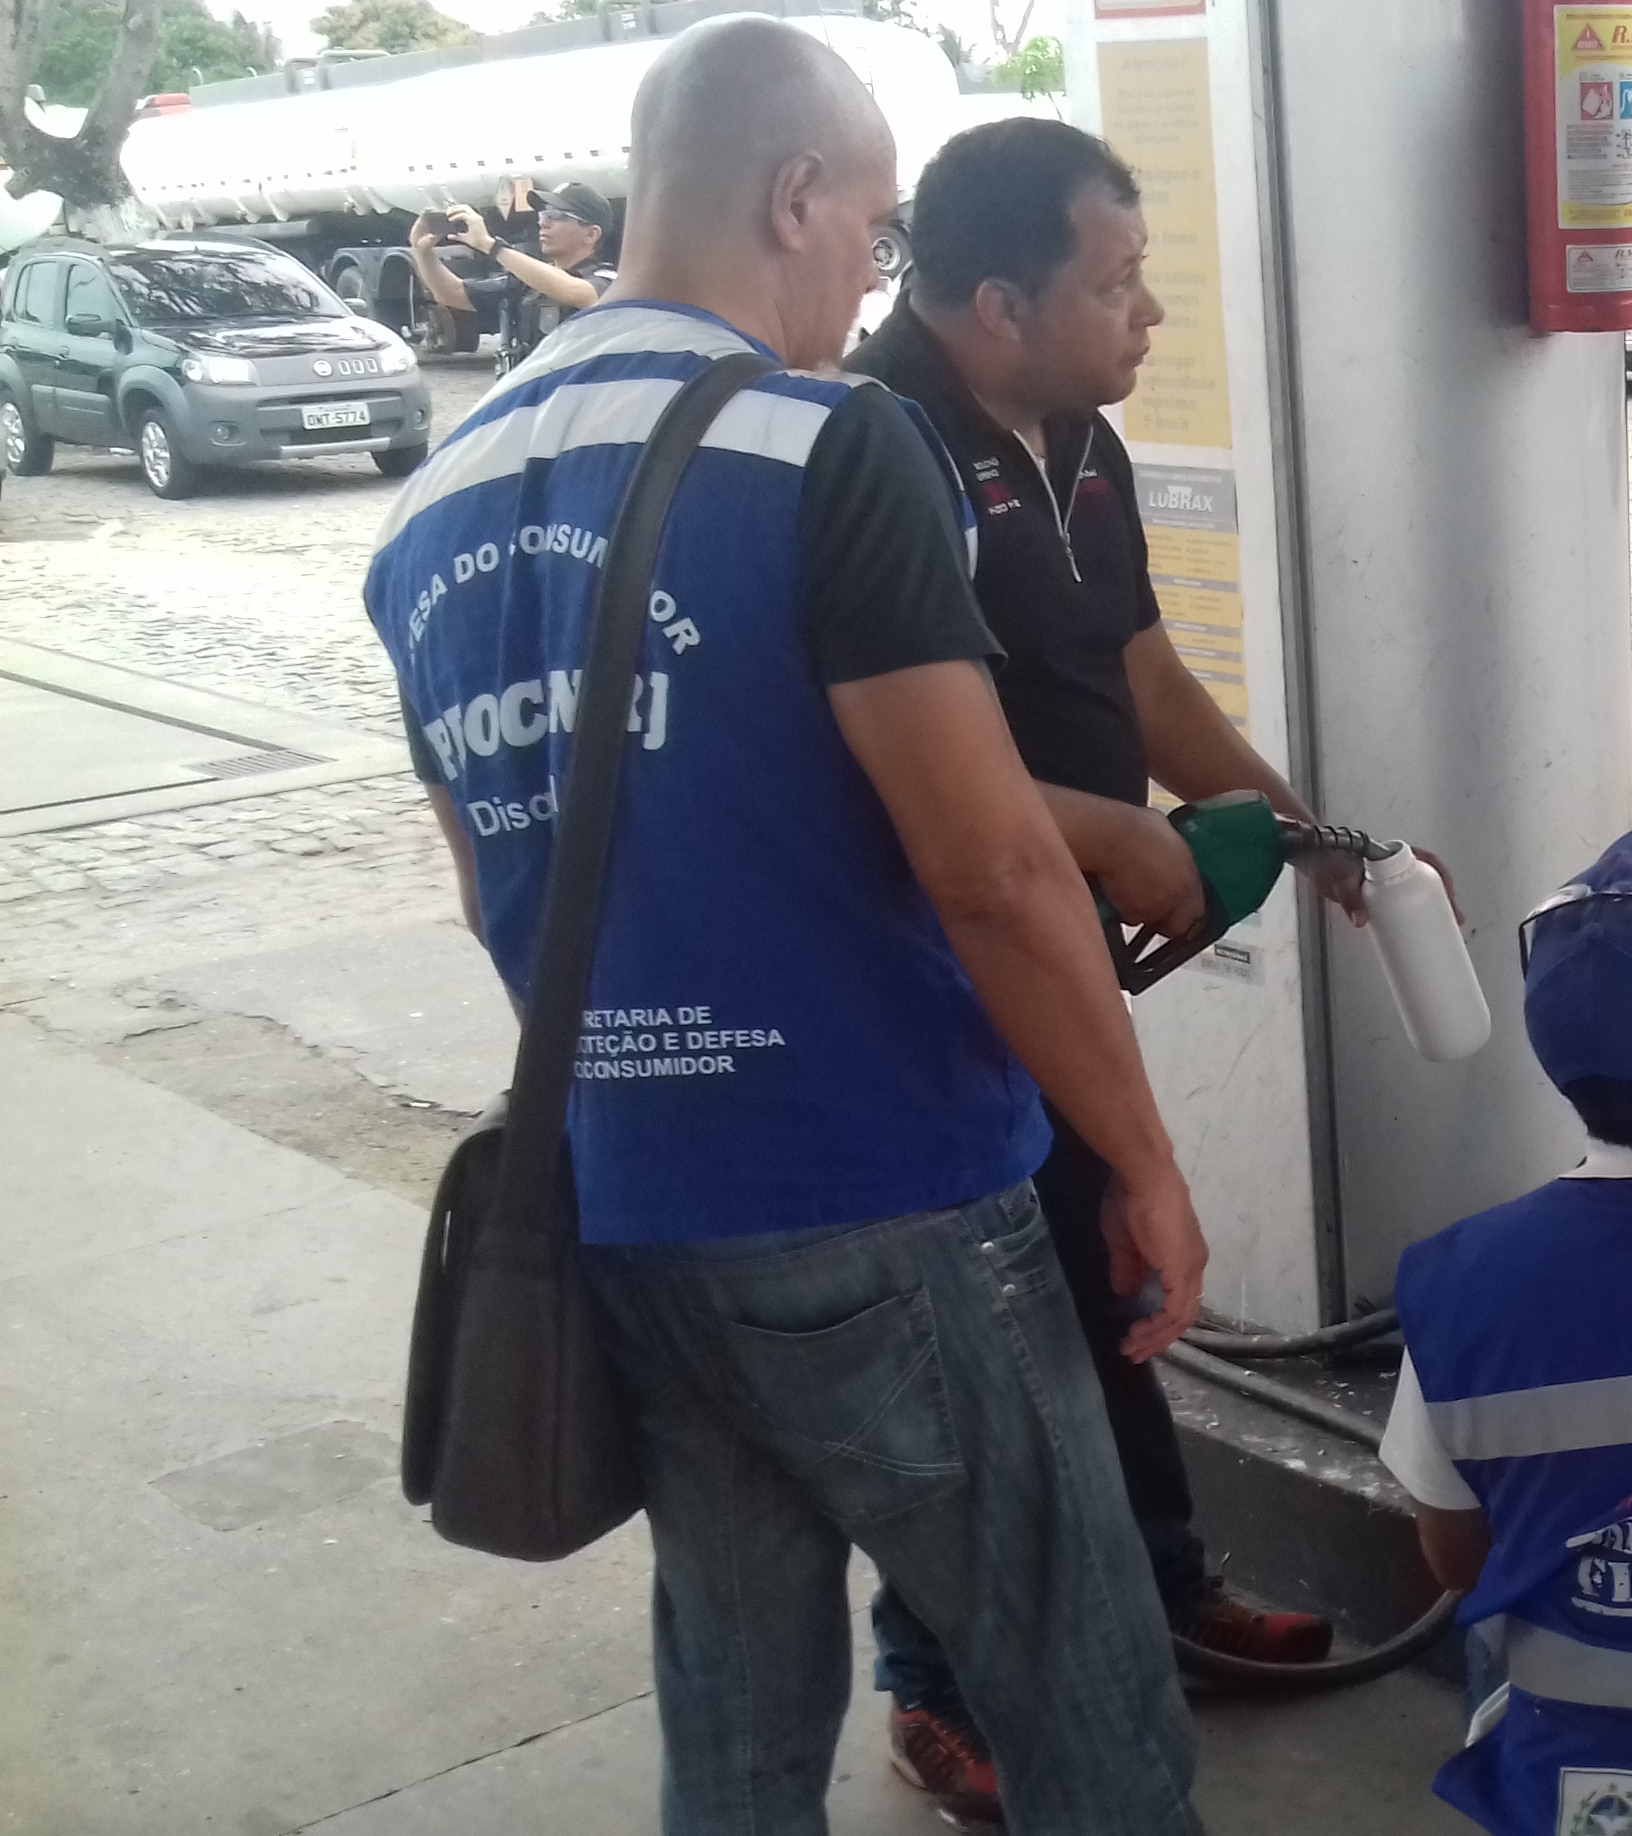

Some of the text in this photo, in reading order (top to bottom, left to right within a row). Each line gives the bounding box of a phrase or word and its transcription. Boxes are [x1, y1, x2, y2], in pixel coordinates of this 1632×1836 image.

[1148, 488, 1214, 513] LUBRAX
[453, 541, 500, 584] DO
[582, 1005, 713, 1029] RETARIA DE
[662, 1032, 681, 1051] E
[686, 1028, 786, 1051] DEFESA
